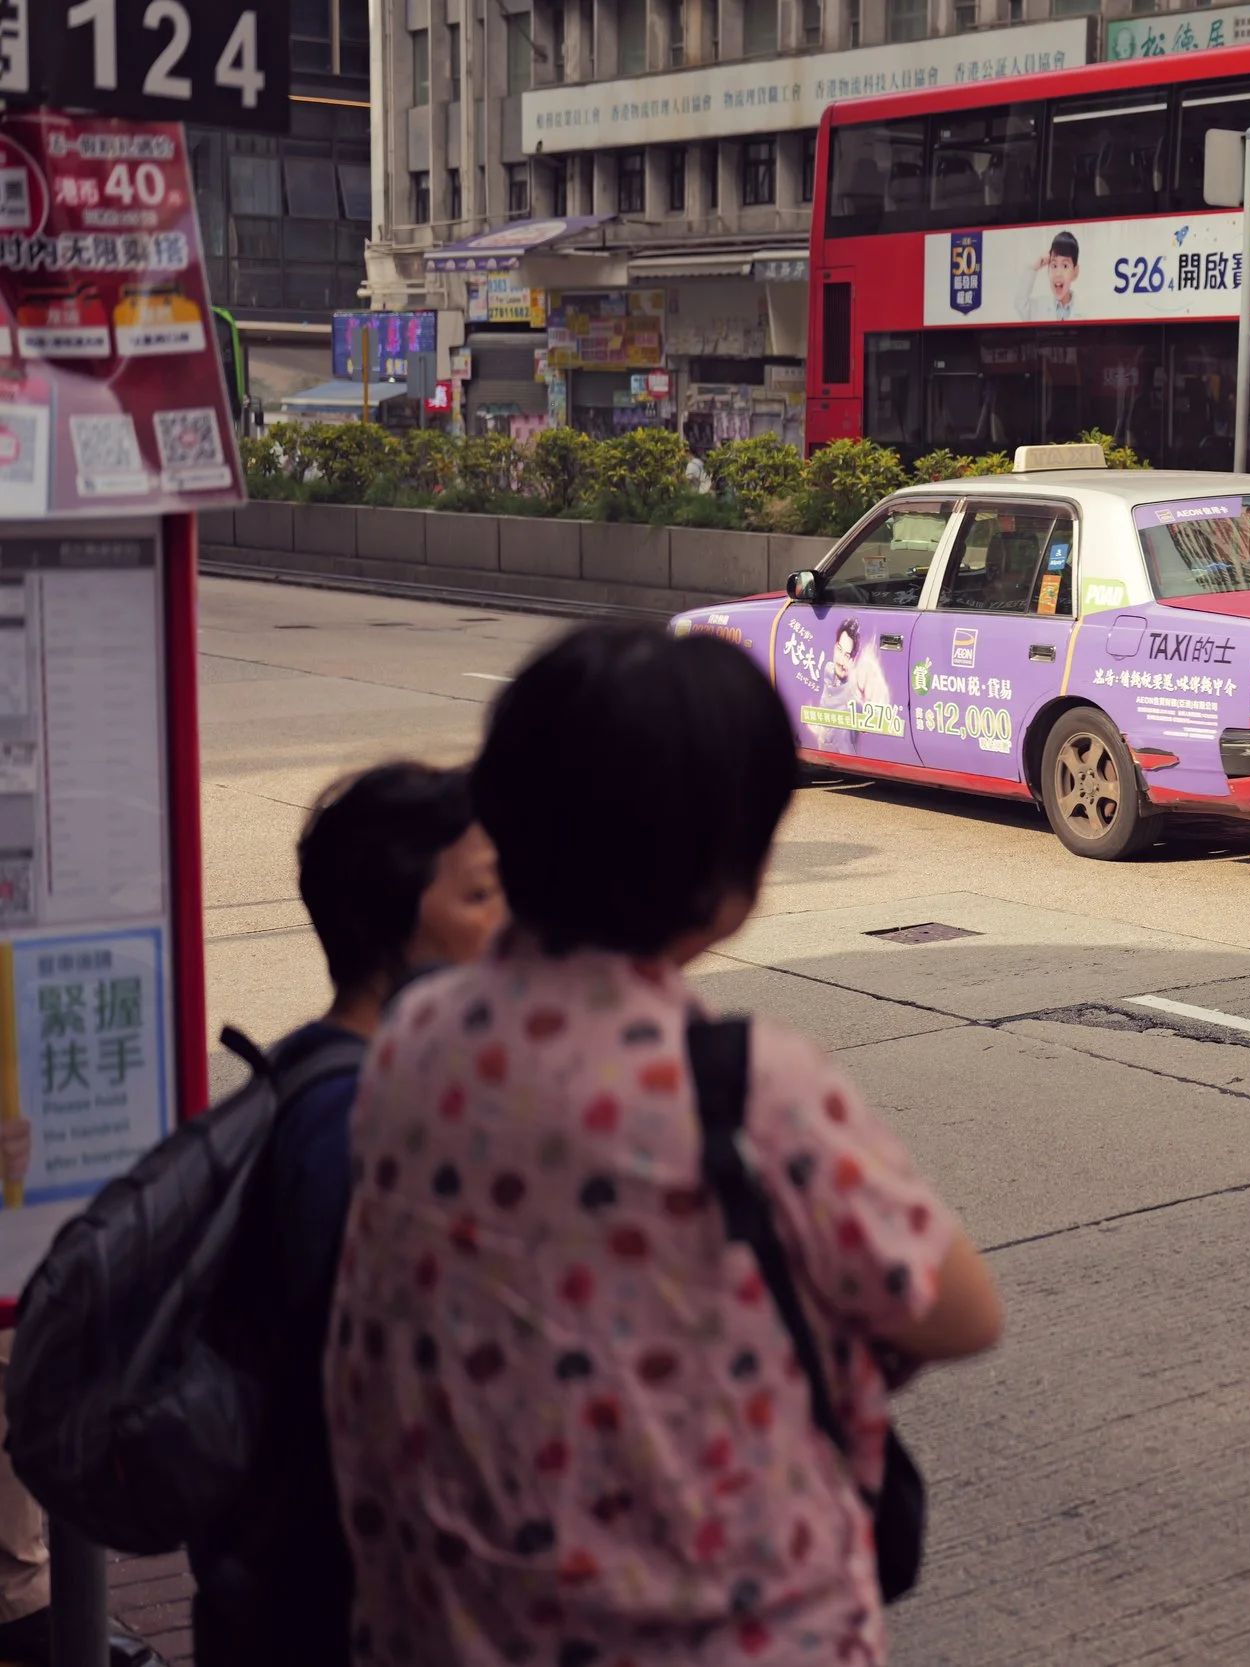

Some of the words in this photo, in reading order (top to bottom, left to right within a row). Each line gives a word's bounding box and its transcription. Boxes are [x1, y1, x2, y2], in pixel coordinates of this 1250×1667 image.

[66, 0, 266, 108] 124
[105, 163, 166, 206] 40
[931, 674, 966, 693] AEON
[925, 702, 1012, 741] $12,000
[38, 975, 144, 1038] 緊握
[41, 1033, 146, 1095] 扶手
